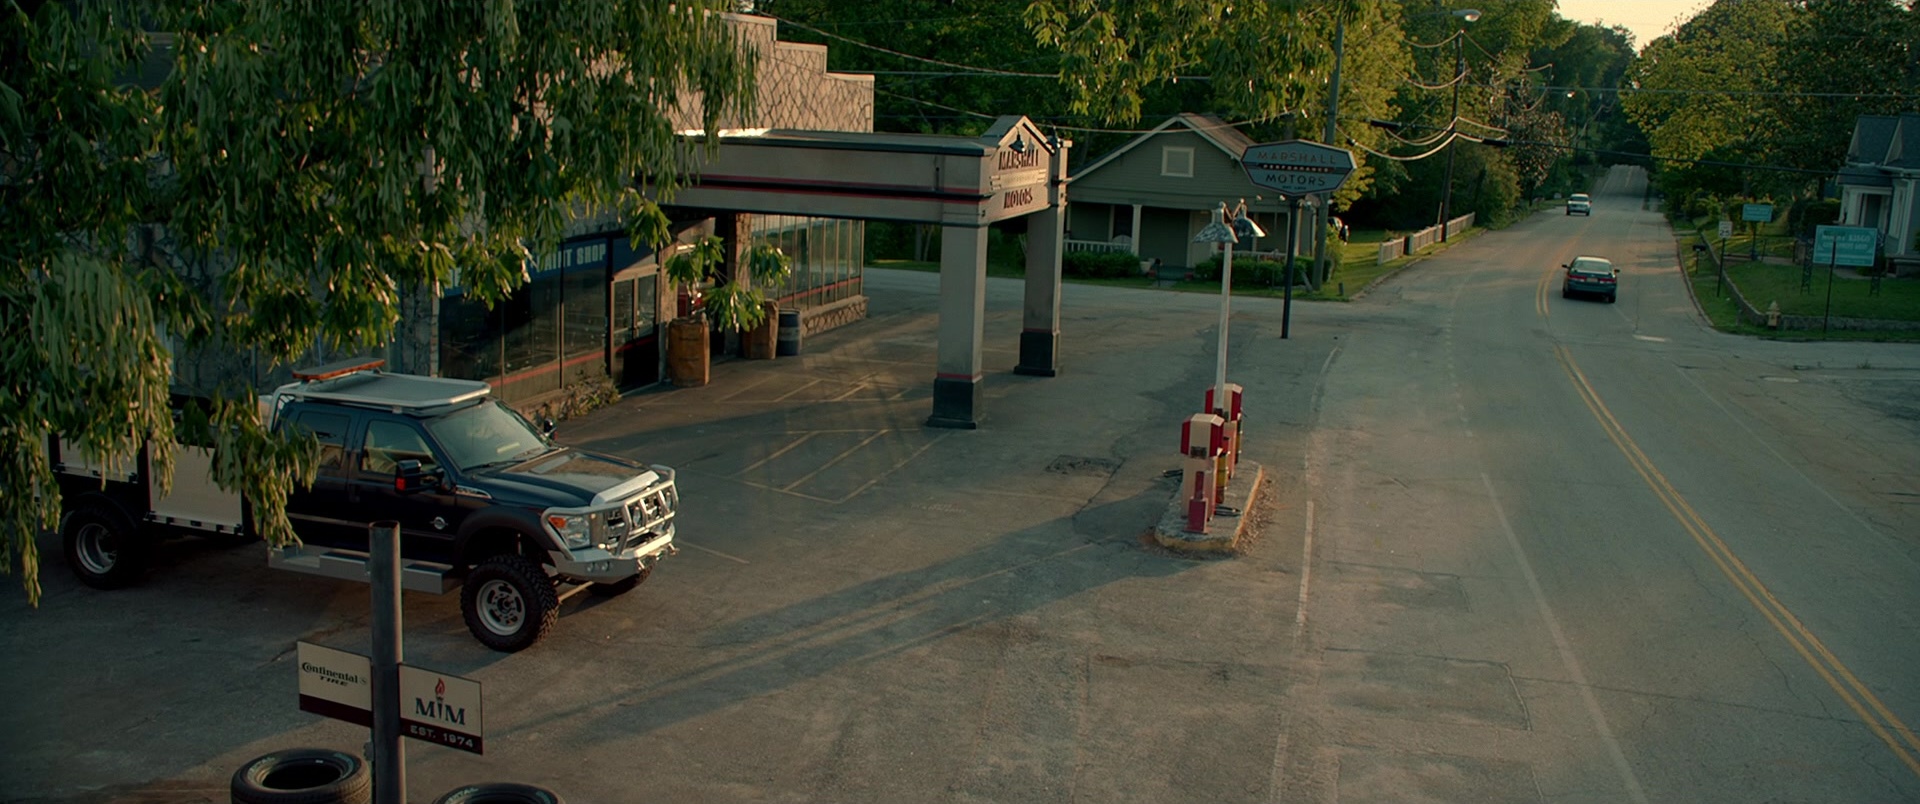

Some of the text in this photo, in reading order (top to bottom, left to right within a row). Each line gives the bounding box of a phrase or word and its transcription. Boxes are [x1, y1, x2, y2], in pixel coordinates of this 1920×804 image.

[1257, 151, 1337, 164] MARSHALL
[1266, 174, 1326, 186] MOTORS
[1003, 187, 1033, 209] MOTORS
[576, 243, 607, 266] SHOP
[302, 662, 358, 684] Continental
[320, 676, 349, 687] TIRE
[410, 725, 474, 748] EST. 1974
